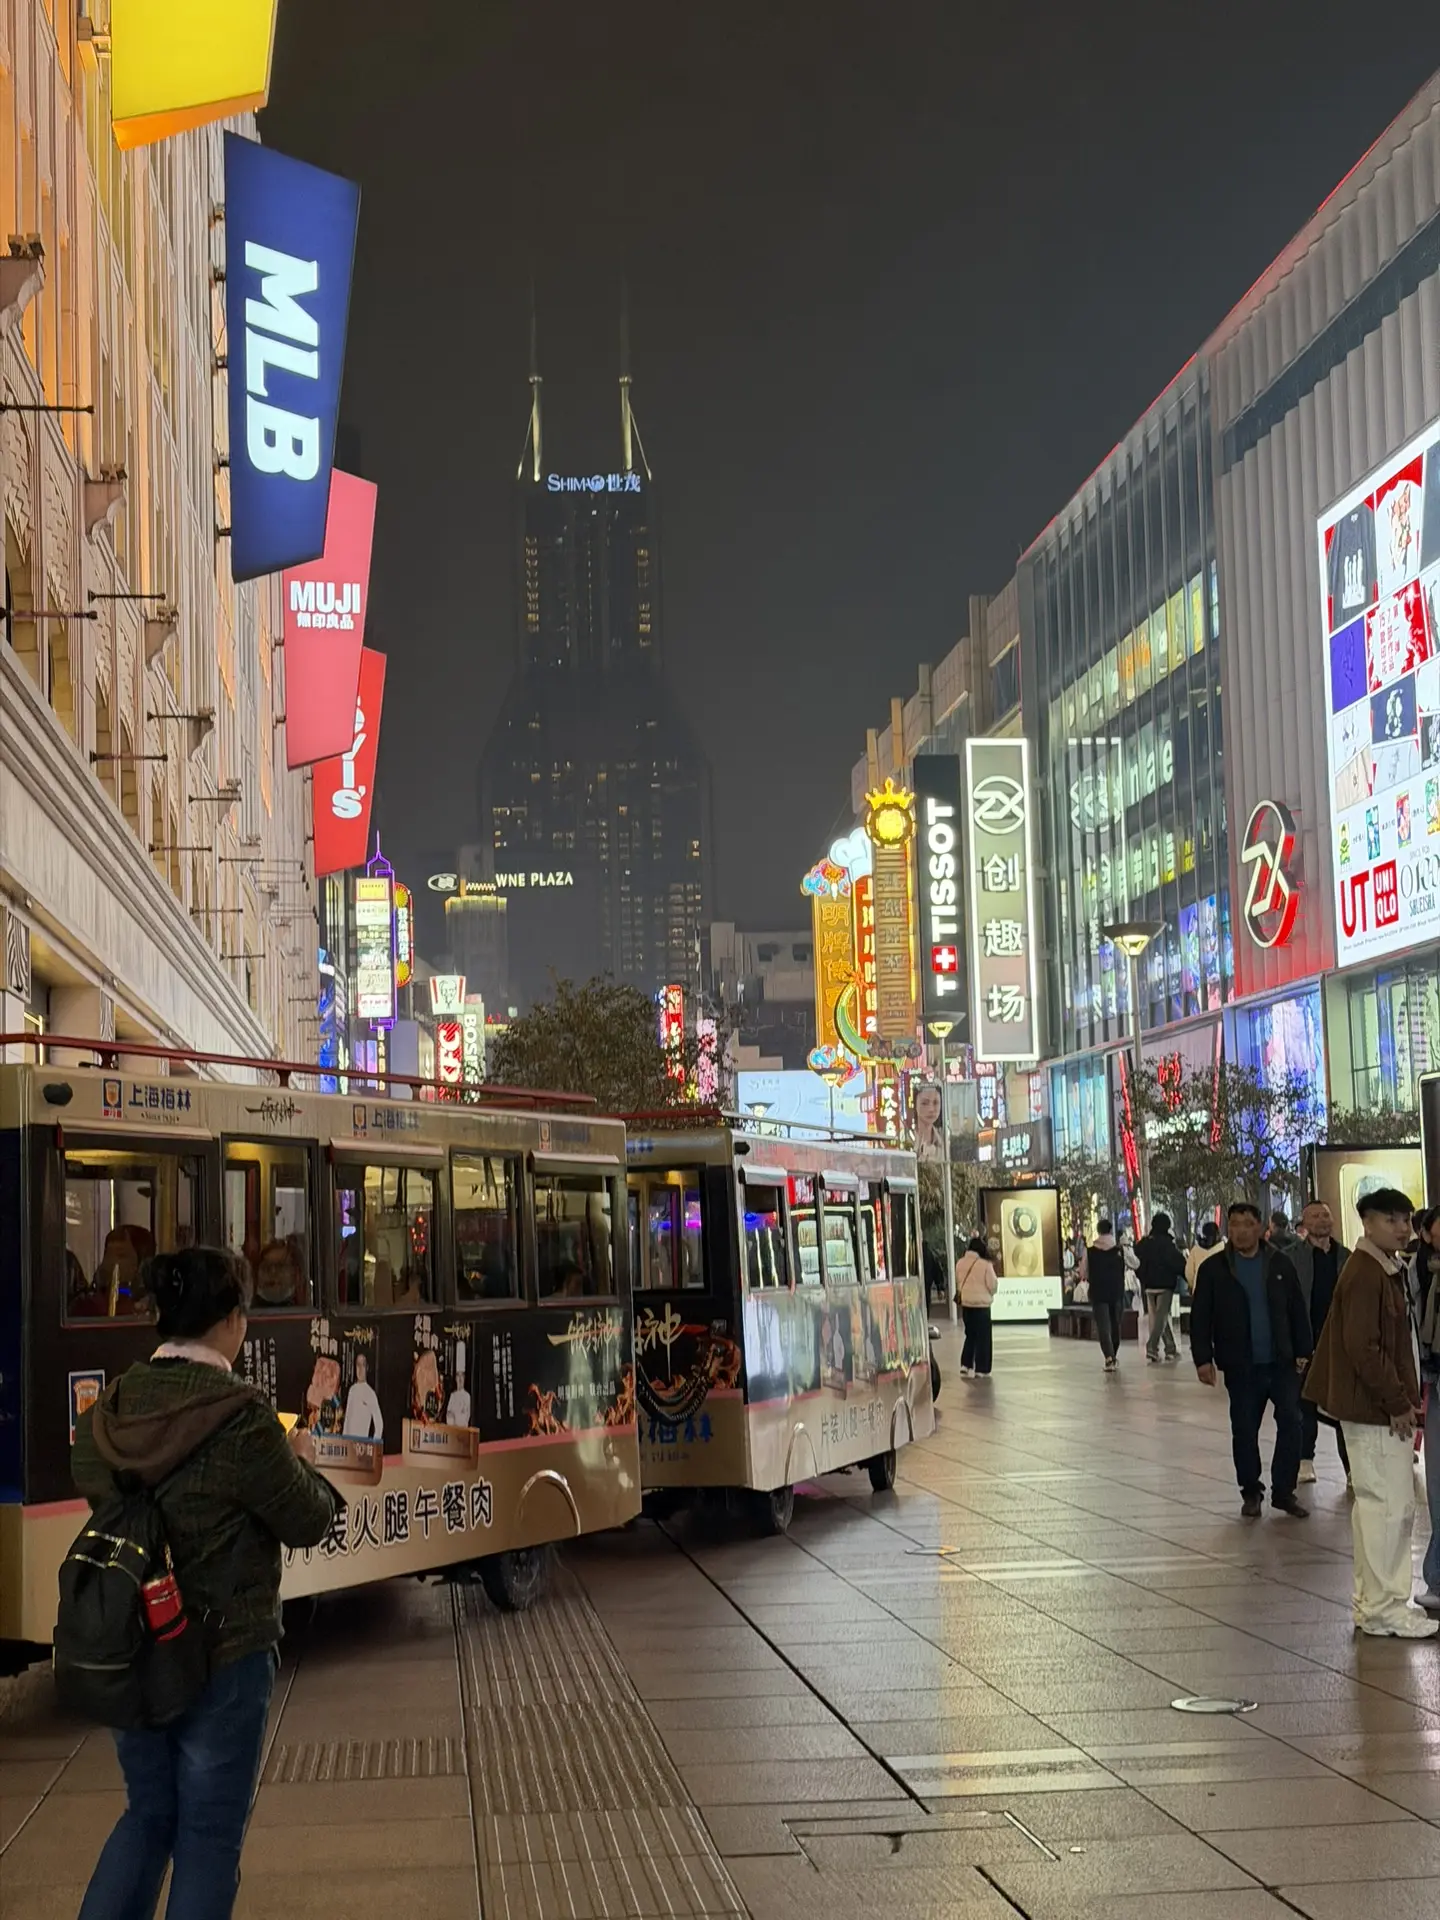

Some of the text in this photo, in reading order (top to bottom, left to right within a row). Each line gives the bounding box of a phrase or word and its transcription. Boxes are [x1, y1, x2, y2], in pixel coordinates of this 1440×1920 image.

[245, 240, 319, 481] MLB
[606, 472, 641, 493] 世茂
[290, 580, 361, 613] MUJI
[531, 872, 574, 887] PLAZA
[927, 797, 958, 943] TISSOT
[1375, 867, 1394, 894] UNI
[1340, 870, 1370, 938] UT
[1377, 893, 1397, 924] QLO
[983, 853, 1026, 1024] 创趣场
